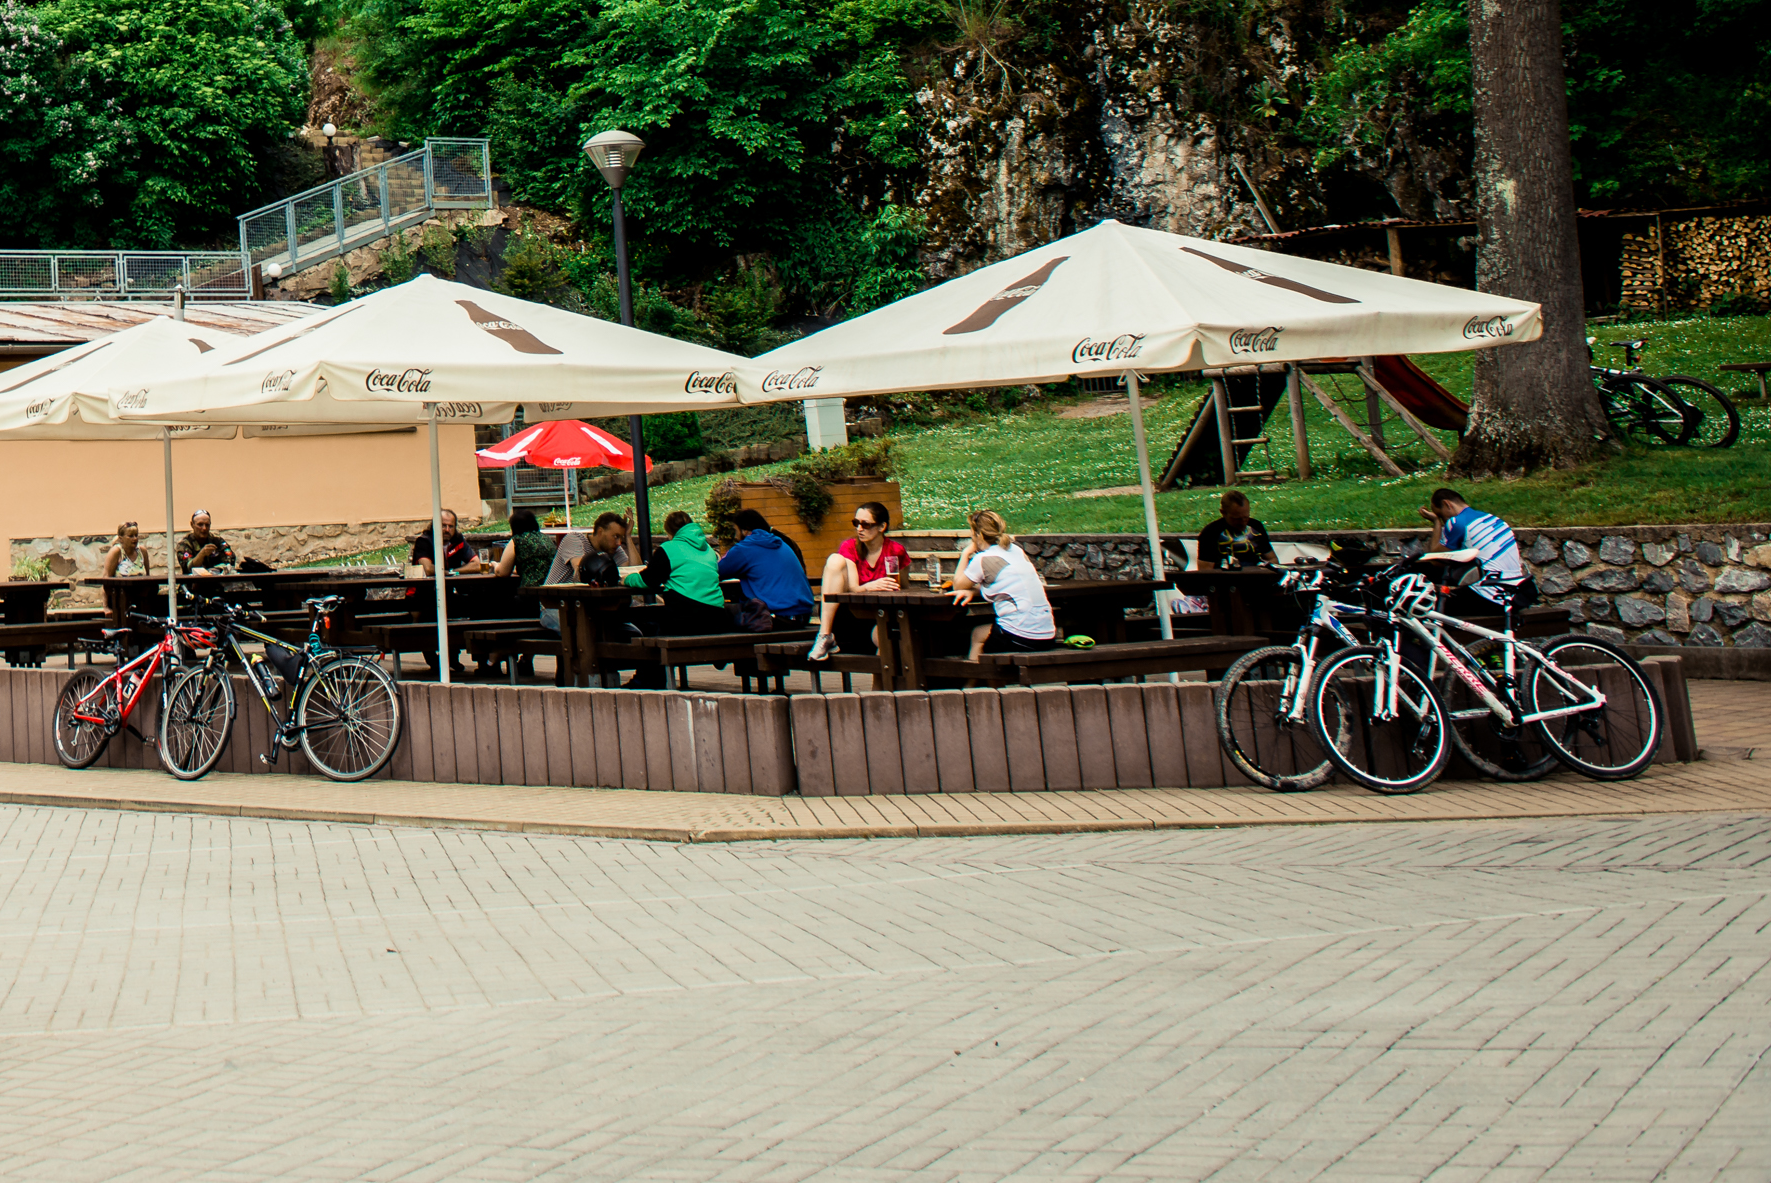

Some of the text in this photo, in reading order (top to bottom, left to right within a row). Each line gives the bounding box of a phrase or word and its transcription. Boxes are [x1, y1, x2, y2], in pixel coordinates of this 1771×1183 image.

[1071, 333, 1147, 364] Coca-Cola
[366, 368, 434, 393] Coca-Cola
[762, 365, 825, 393] Coca-Cola
